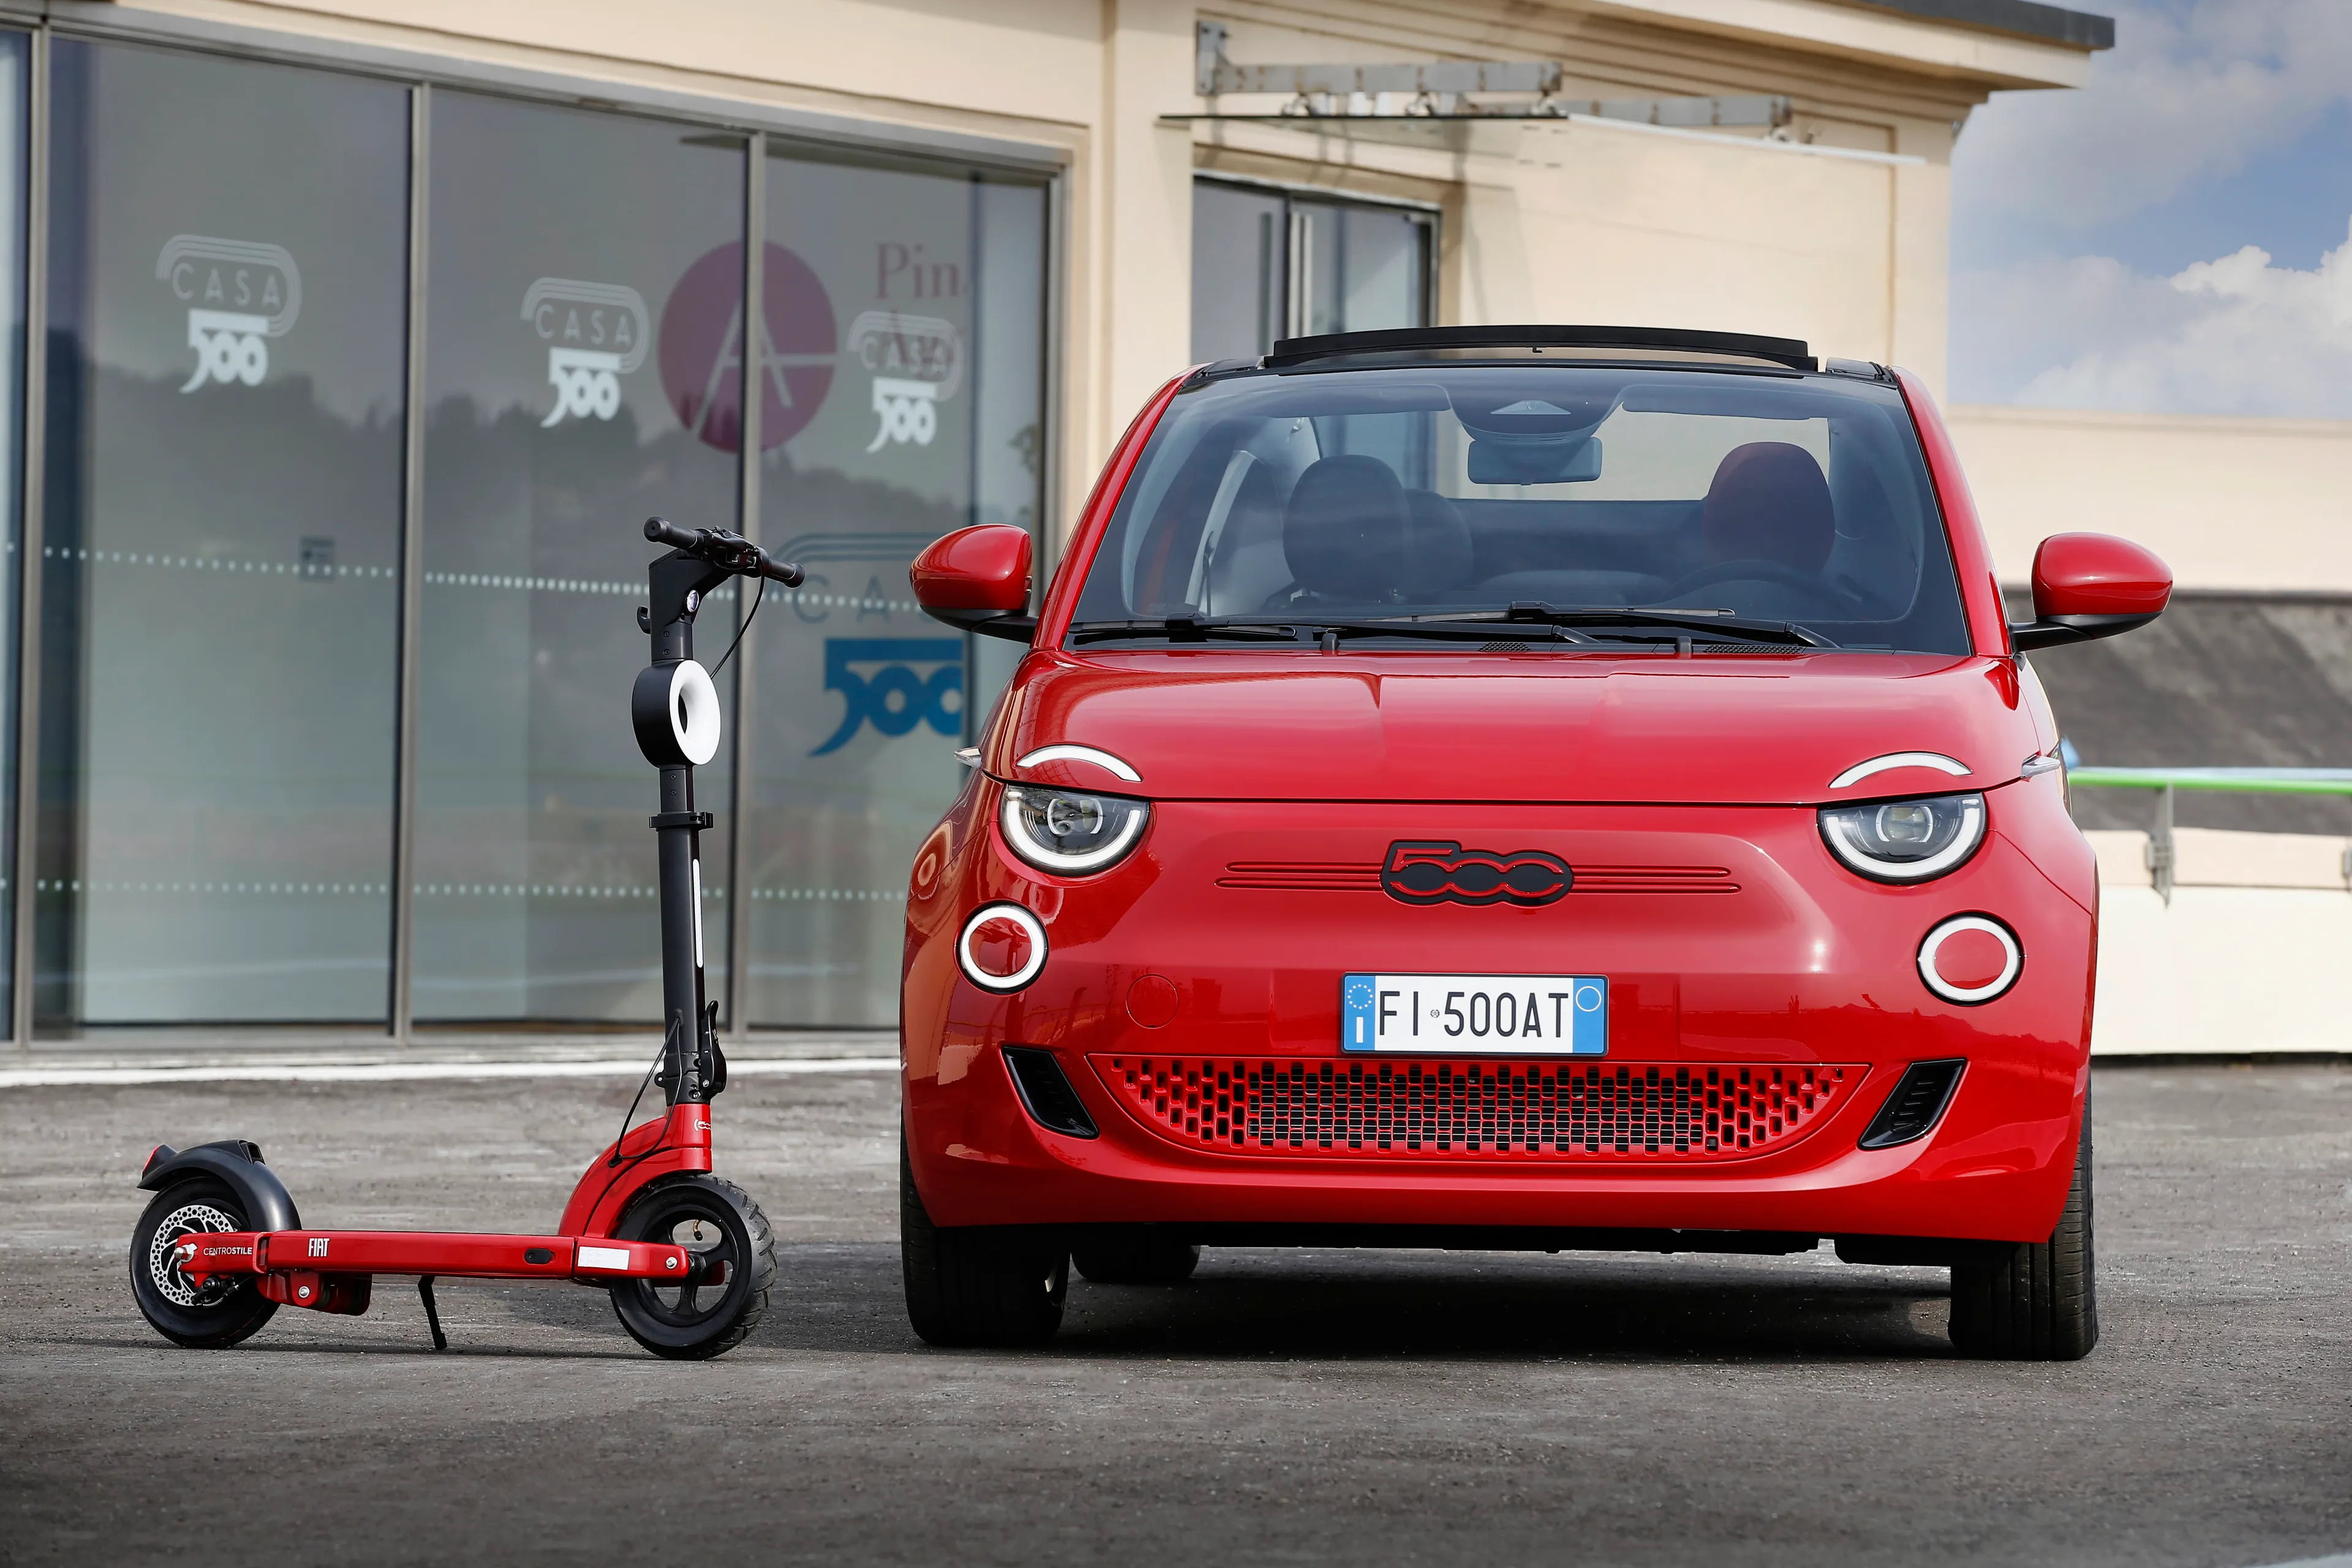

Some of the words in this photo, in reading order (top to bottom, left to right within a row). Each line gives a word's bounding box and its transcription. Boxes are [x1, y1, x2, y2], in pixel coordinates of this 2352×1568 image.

[172, 262, 281, 307] CASA
[535, 304, 631, 347] CASA
[179, 307, 268, 393] 500
[540, 347, 622, 428] 500
[865, 376, 937, 453] 500
[1389, 848, 1564, 898] 500
[203, 1246, 252, 1256] CENTROSTILE
[308, 1237, 330, 1257] FIAT
